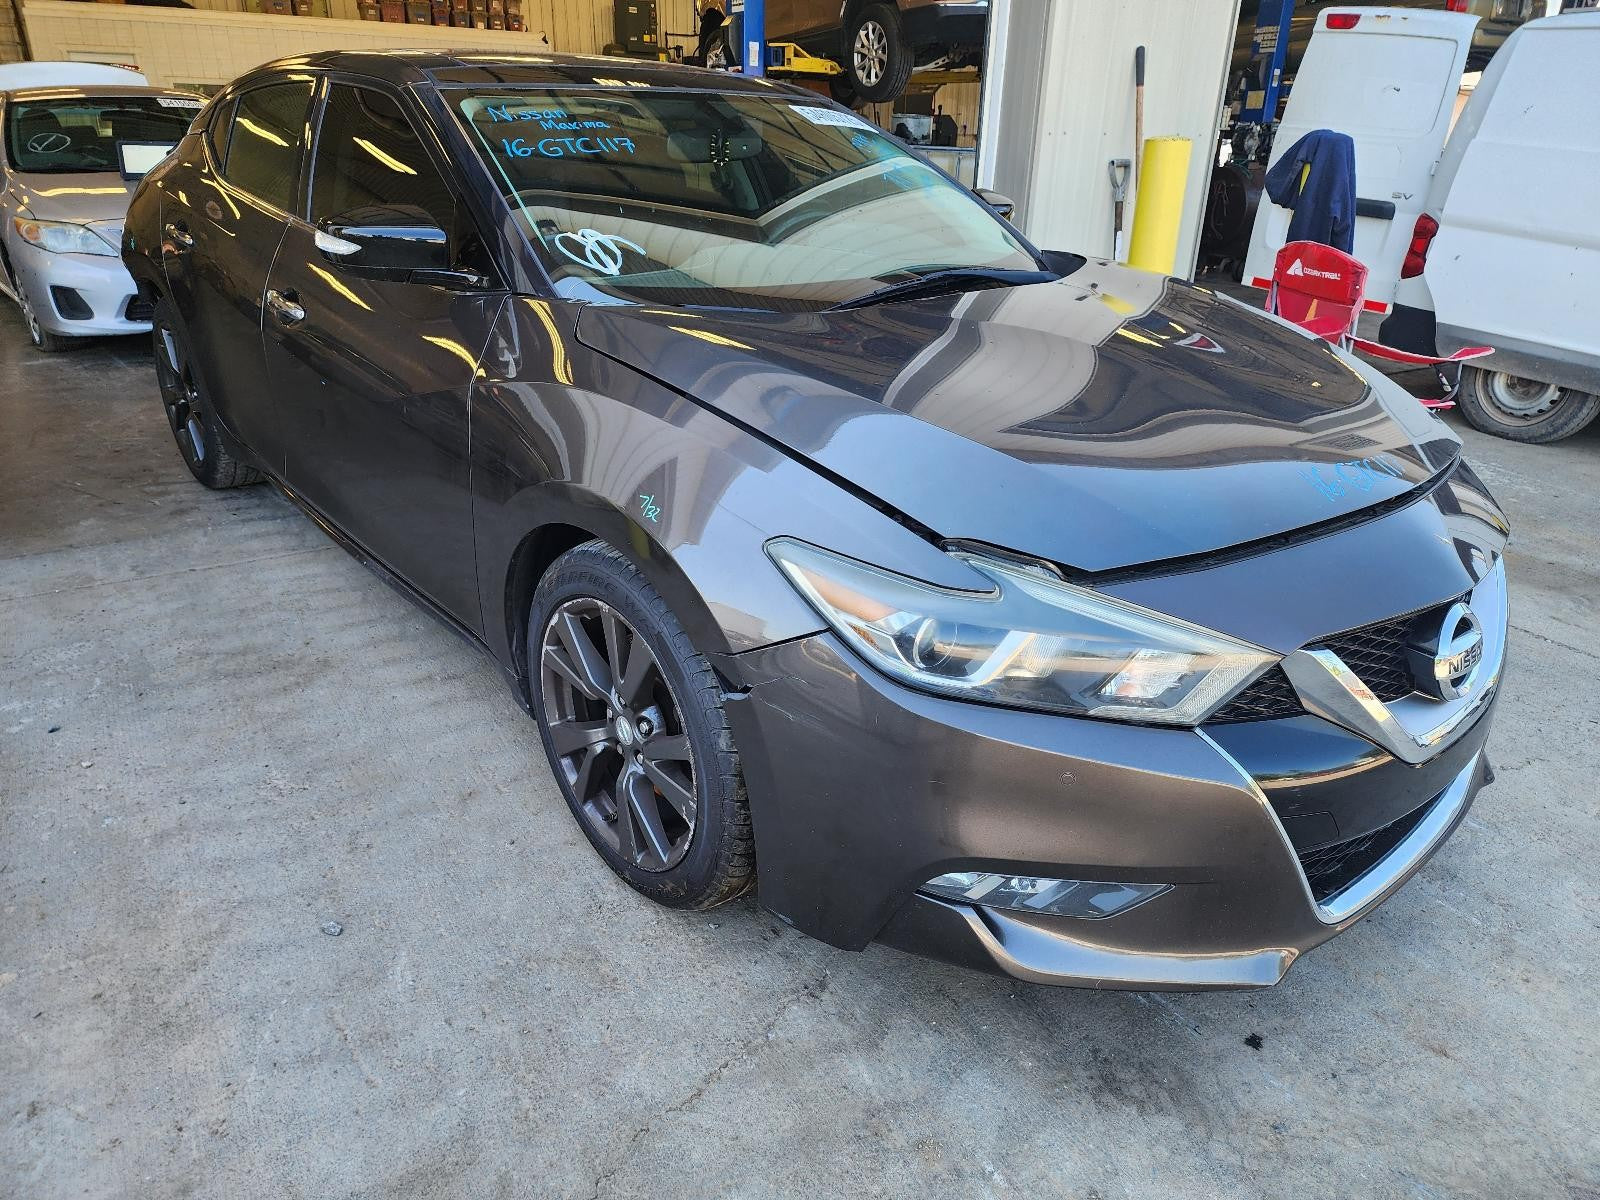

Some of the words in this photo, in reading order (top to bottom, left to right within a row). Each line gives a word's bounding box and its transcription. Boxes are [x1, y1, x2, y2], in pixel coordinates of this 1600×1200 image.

[487, 104, 568, 122] Nissan
[540, 119, 611, 130] Maxima
[501, 137, 636, 158] 16-GTC117
[1391, 191, 1414, 200] SV
